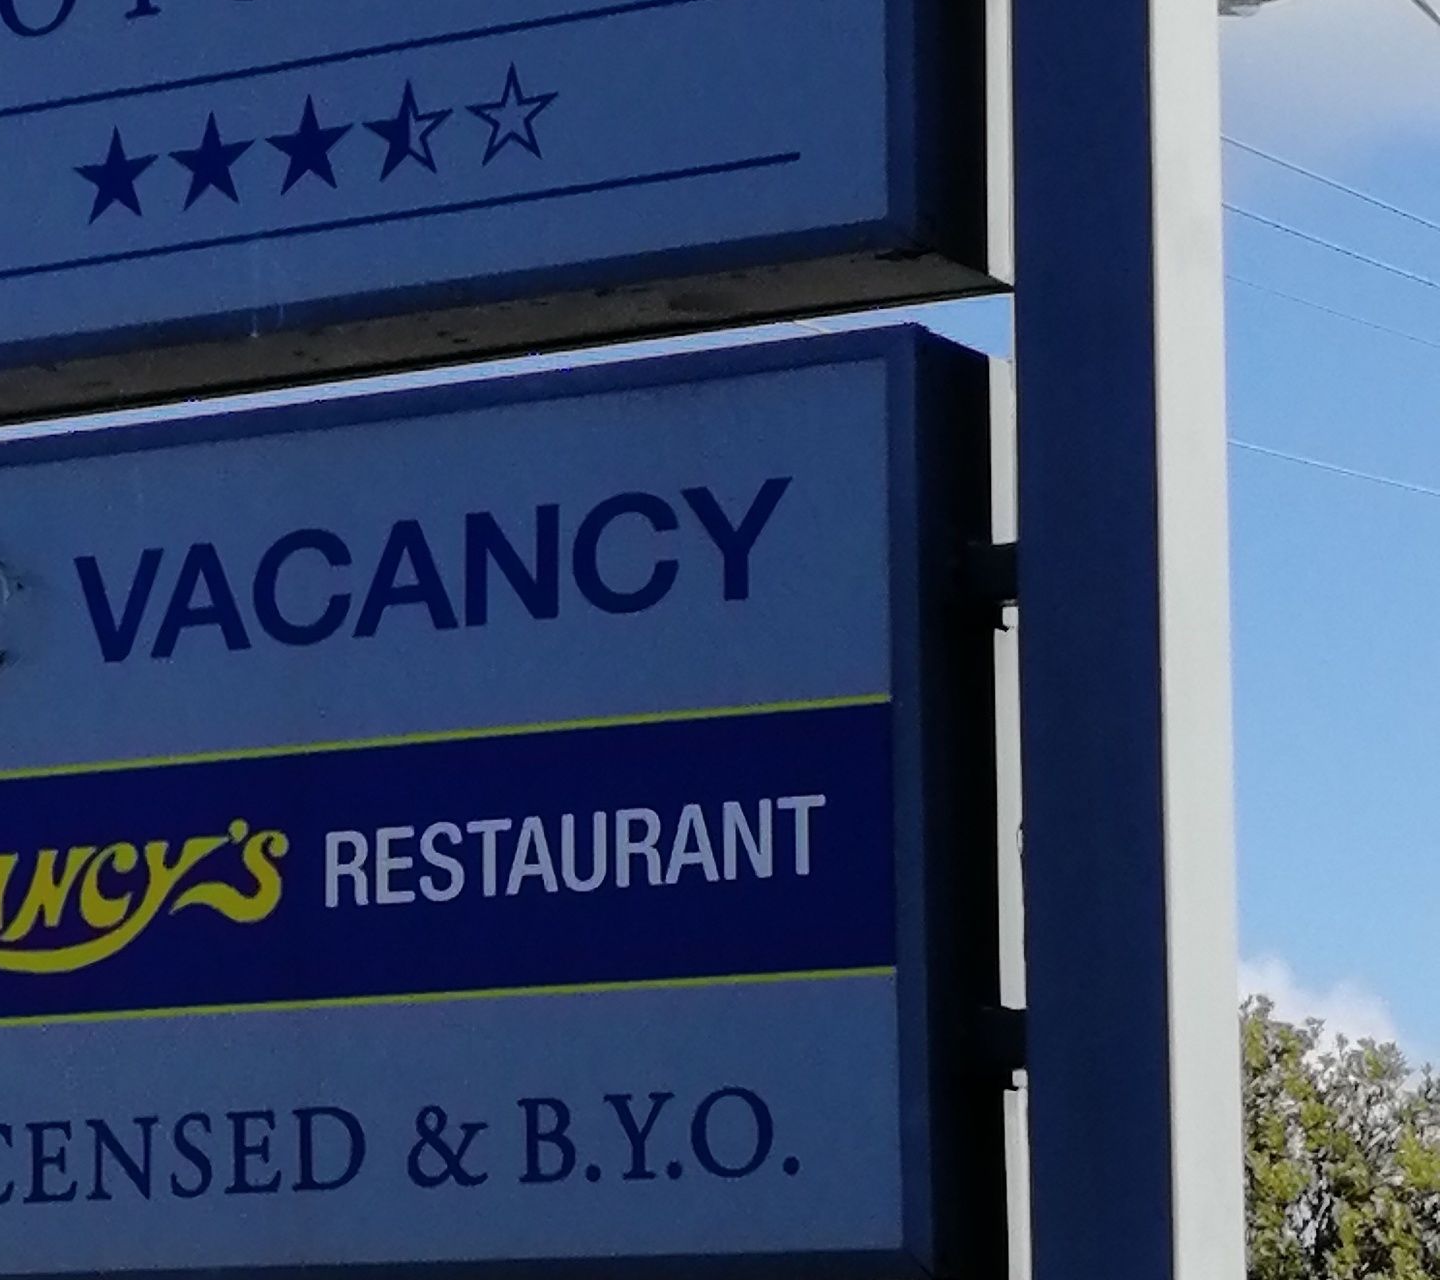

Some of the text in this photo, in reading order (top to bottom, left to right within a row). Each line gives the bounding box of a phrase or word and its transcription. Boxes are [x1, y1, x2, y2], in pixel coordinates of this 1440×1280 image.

[74, 477, 793, 665] VACANCY
[324, 794, 827, 909] RESTAURANT
[407, 1105, 489, 1189] &
[517, 1086, 802, 1187] B.Y.O.
